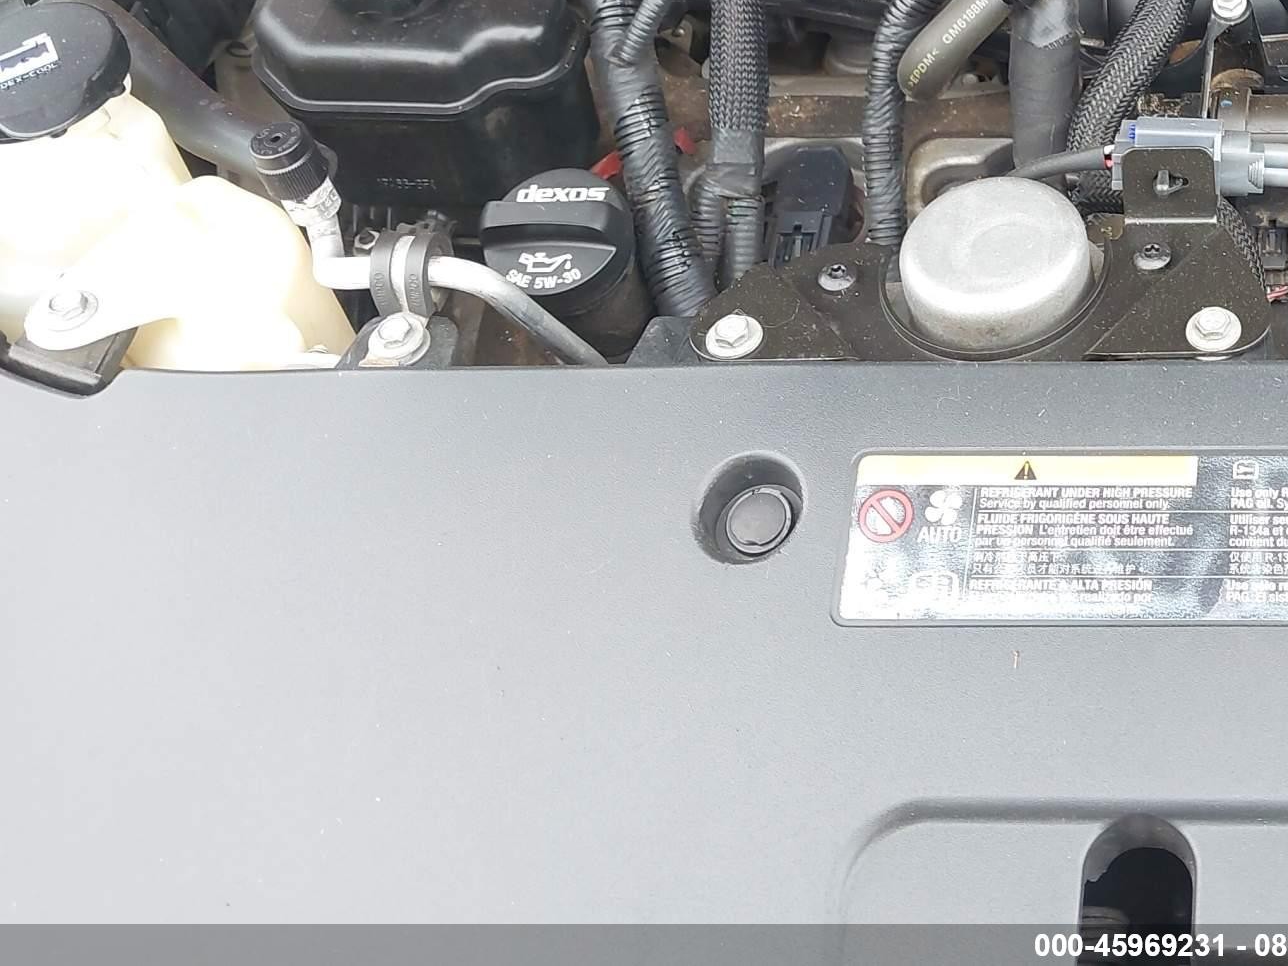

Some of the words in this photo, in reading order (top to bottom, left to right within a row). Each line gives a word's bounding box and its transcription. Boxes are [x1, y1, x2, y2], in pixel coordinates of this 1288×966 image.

[516, 184, 610, 202] dexos
[505, 269, 532, 288] SAE
[533, 268, 582, 289] 5W-30
[980, 487, 1060, 498] REFRIGERANT
[1061, 487, 1100, 497] UNDER
[1102, 487, 1131, 497] HIGH
[1133, 487, 1193, 498] PRESSURE
[1231, 487, 1251, 498] Use
[1254, 487, 1279, 500] only
[979, 498, 1020, 509] Service
[1023, 498, 1037, 511] by
[1039, 498, 1086, 511] qualified
[1089, 498, 1143, 511] personnel
[1230, 499, 1253, 509] PAG
[977, 513, 1018, 524] FLUIDE
[1098, 514, 1129, 524] SOUS
[1131, 514, 1170, 524] HAUTE
[918, 525, 962, 544] AUTO
[1100, 525, 1121, 537] doit
[1123, 524, 1146, 536] être
[1147, 524, 1193, 536] effectué
[1229, 525, 1270, 536] R-134a
[1271, 526, 1283, 536] et
[975, 537, 995, 548] par
[1071, 535, 1112, 548] qualifié
[1071, 580, 1100, 590] ALTA
[1101, 578, 1153, 591] PRESIÓN
